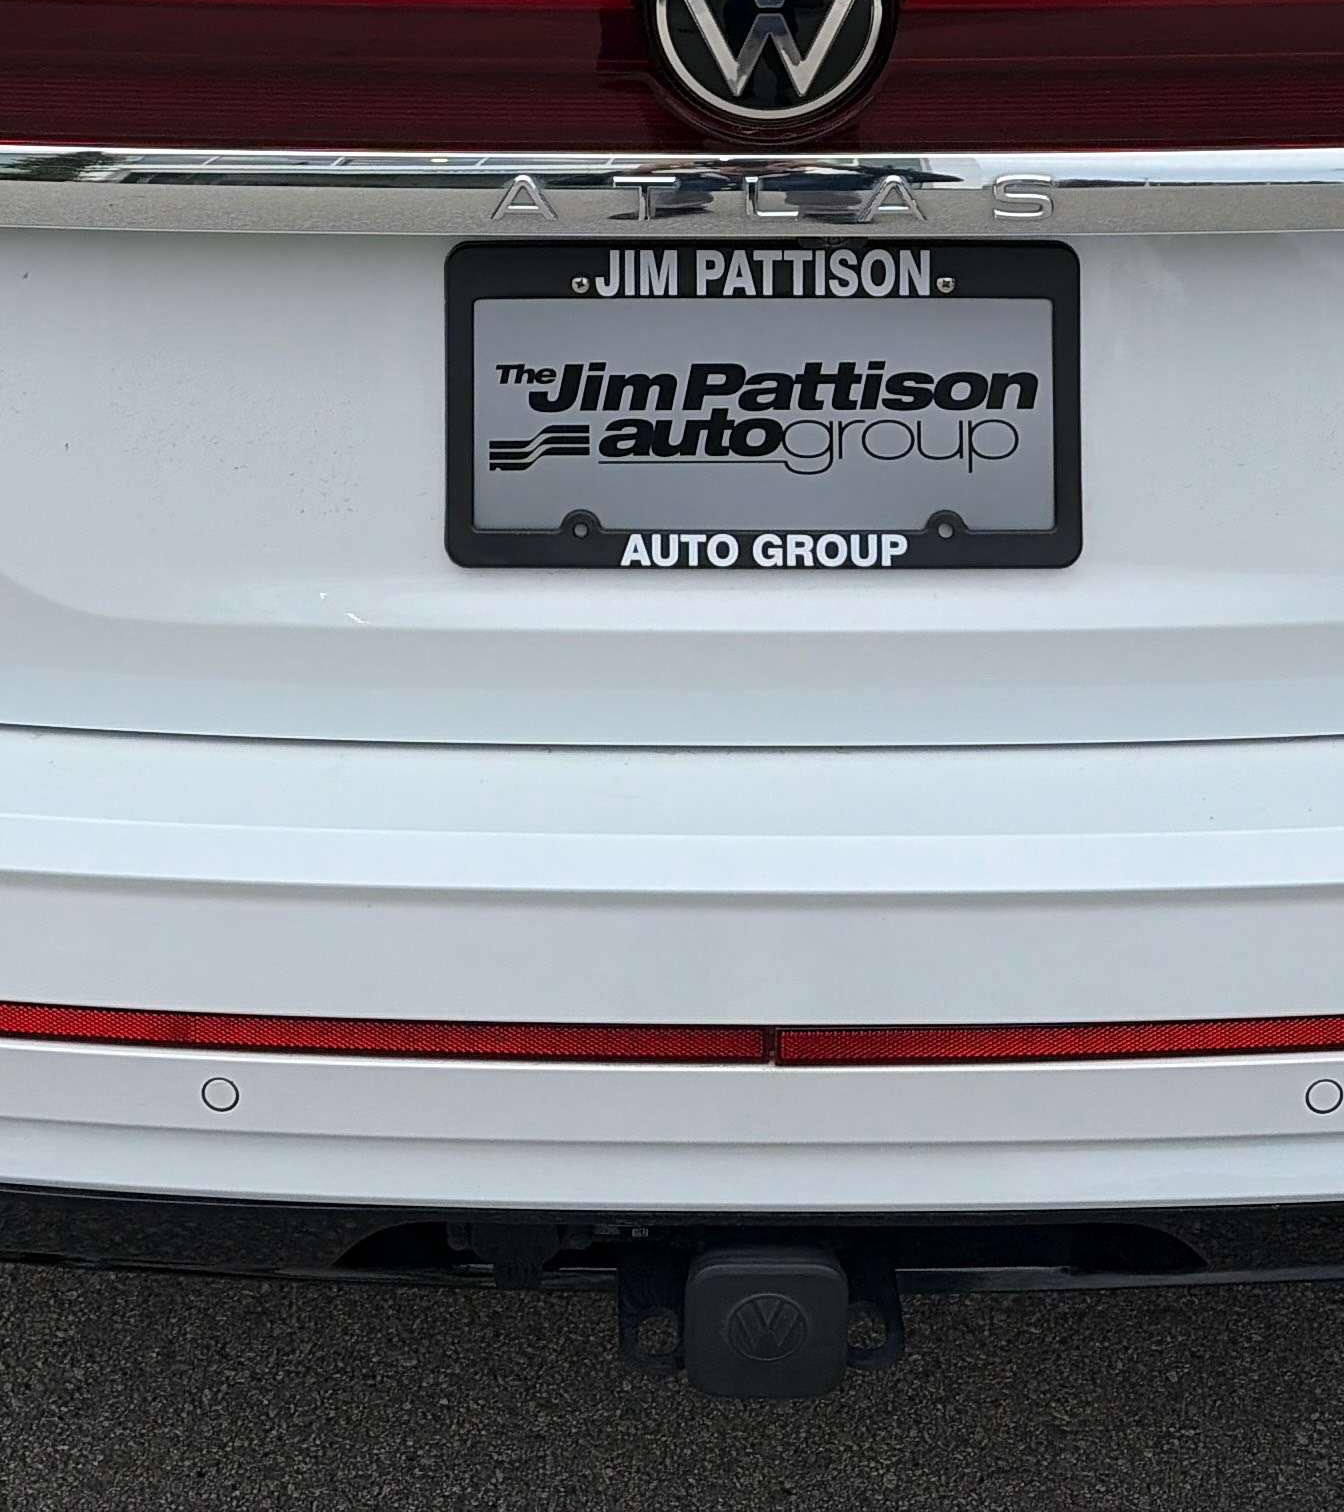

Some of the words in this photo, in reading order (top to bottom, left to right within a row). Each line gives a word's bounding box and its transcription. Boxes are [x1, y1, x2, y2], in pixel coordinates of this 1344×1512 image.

[490, 174, 1057, 222] ATLAS
[595, 249, 678, 297] JIM
[697, 249, 931, 297] PATTISON
[495, 363, 557, 385] The
[682, 360, 1039, 411] Pattison
[620, 533, 738, 568] AUTO
[753, 533, 909, 568] GROUP
